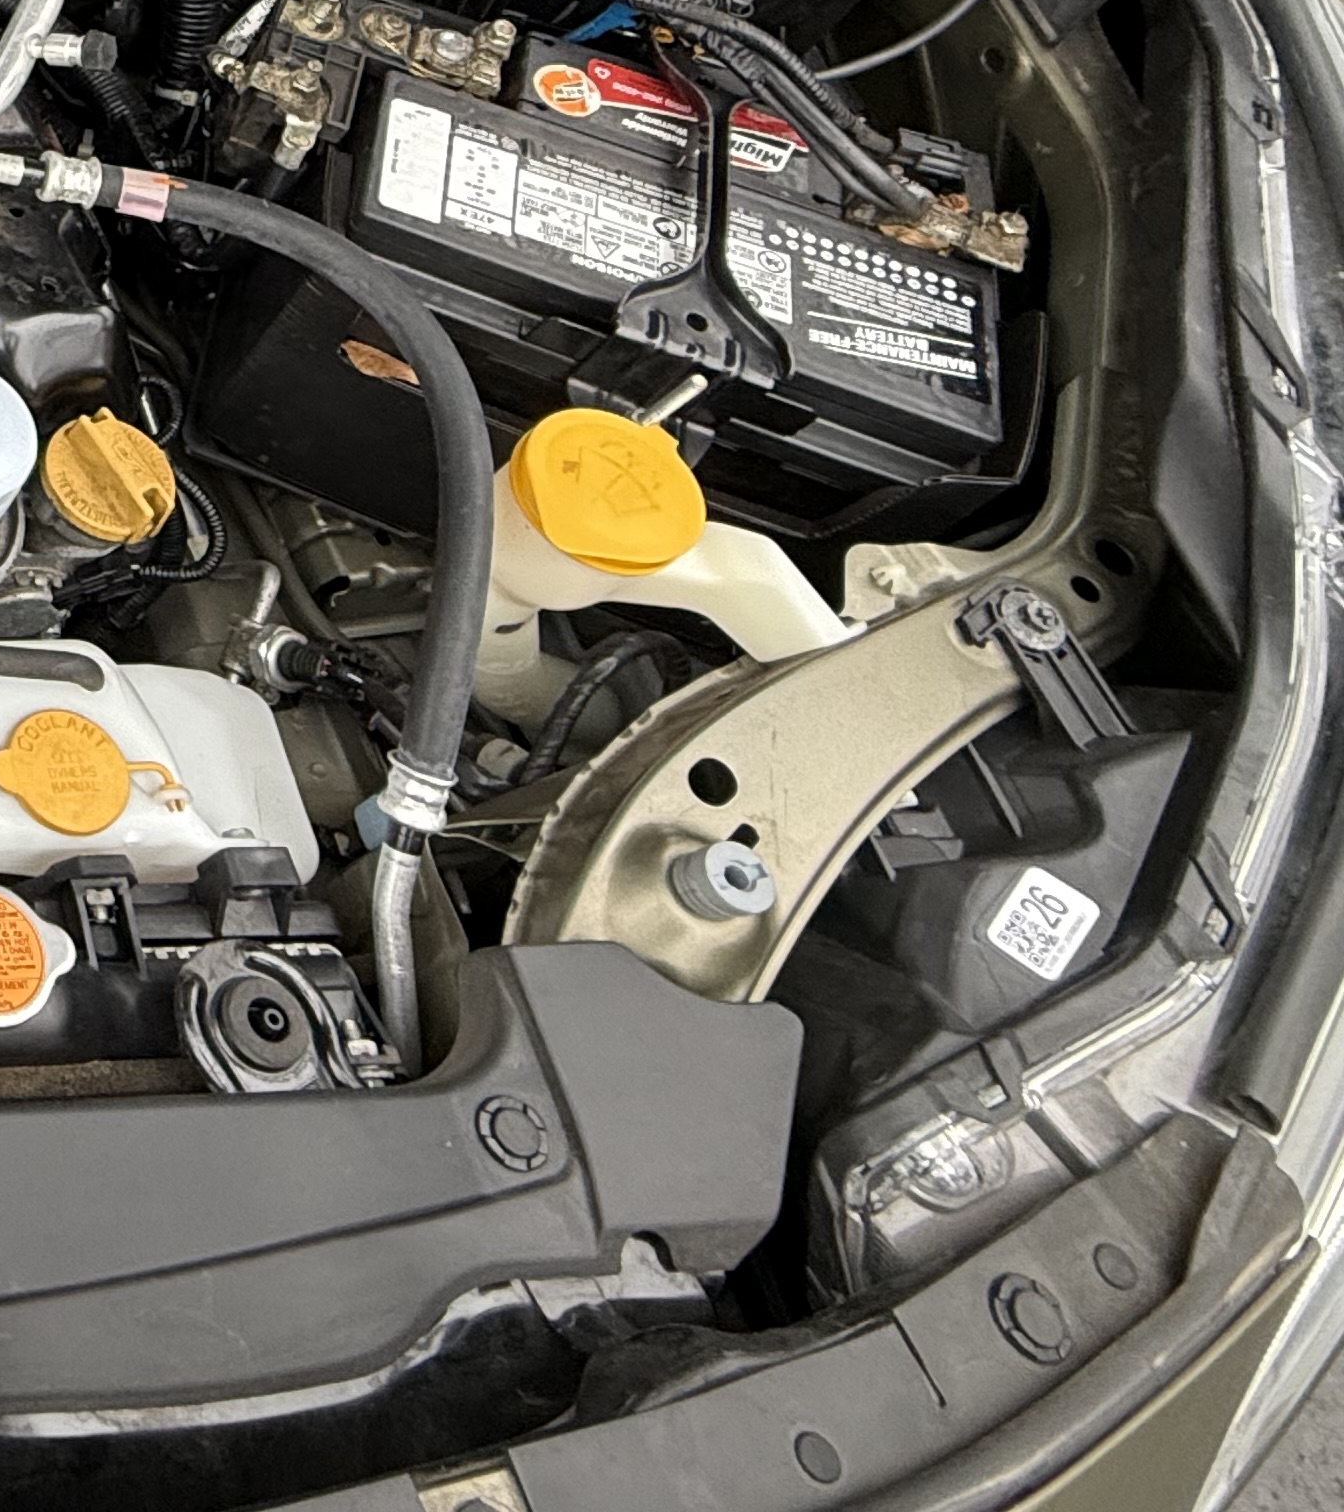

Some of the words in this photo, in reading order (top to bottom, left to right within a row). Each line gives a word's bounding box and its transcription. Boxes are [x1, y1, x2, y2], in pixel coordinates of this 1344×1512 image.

[621, 118, 688, 147] Nationwide
[635, 112, 688, 137] Warranty
[460, 207, 495, 224] 47EX
[808, 329, 978, 374] MAINTENANCE-FREE
[855, 327, 930, 351] BATTERY
[17, 715, 110, 752] COOLANT
[51, 781, 101, 793] MANUAL
[1020, 885, 1069, 929] 26
